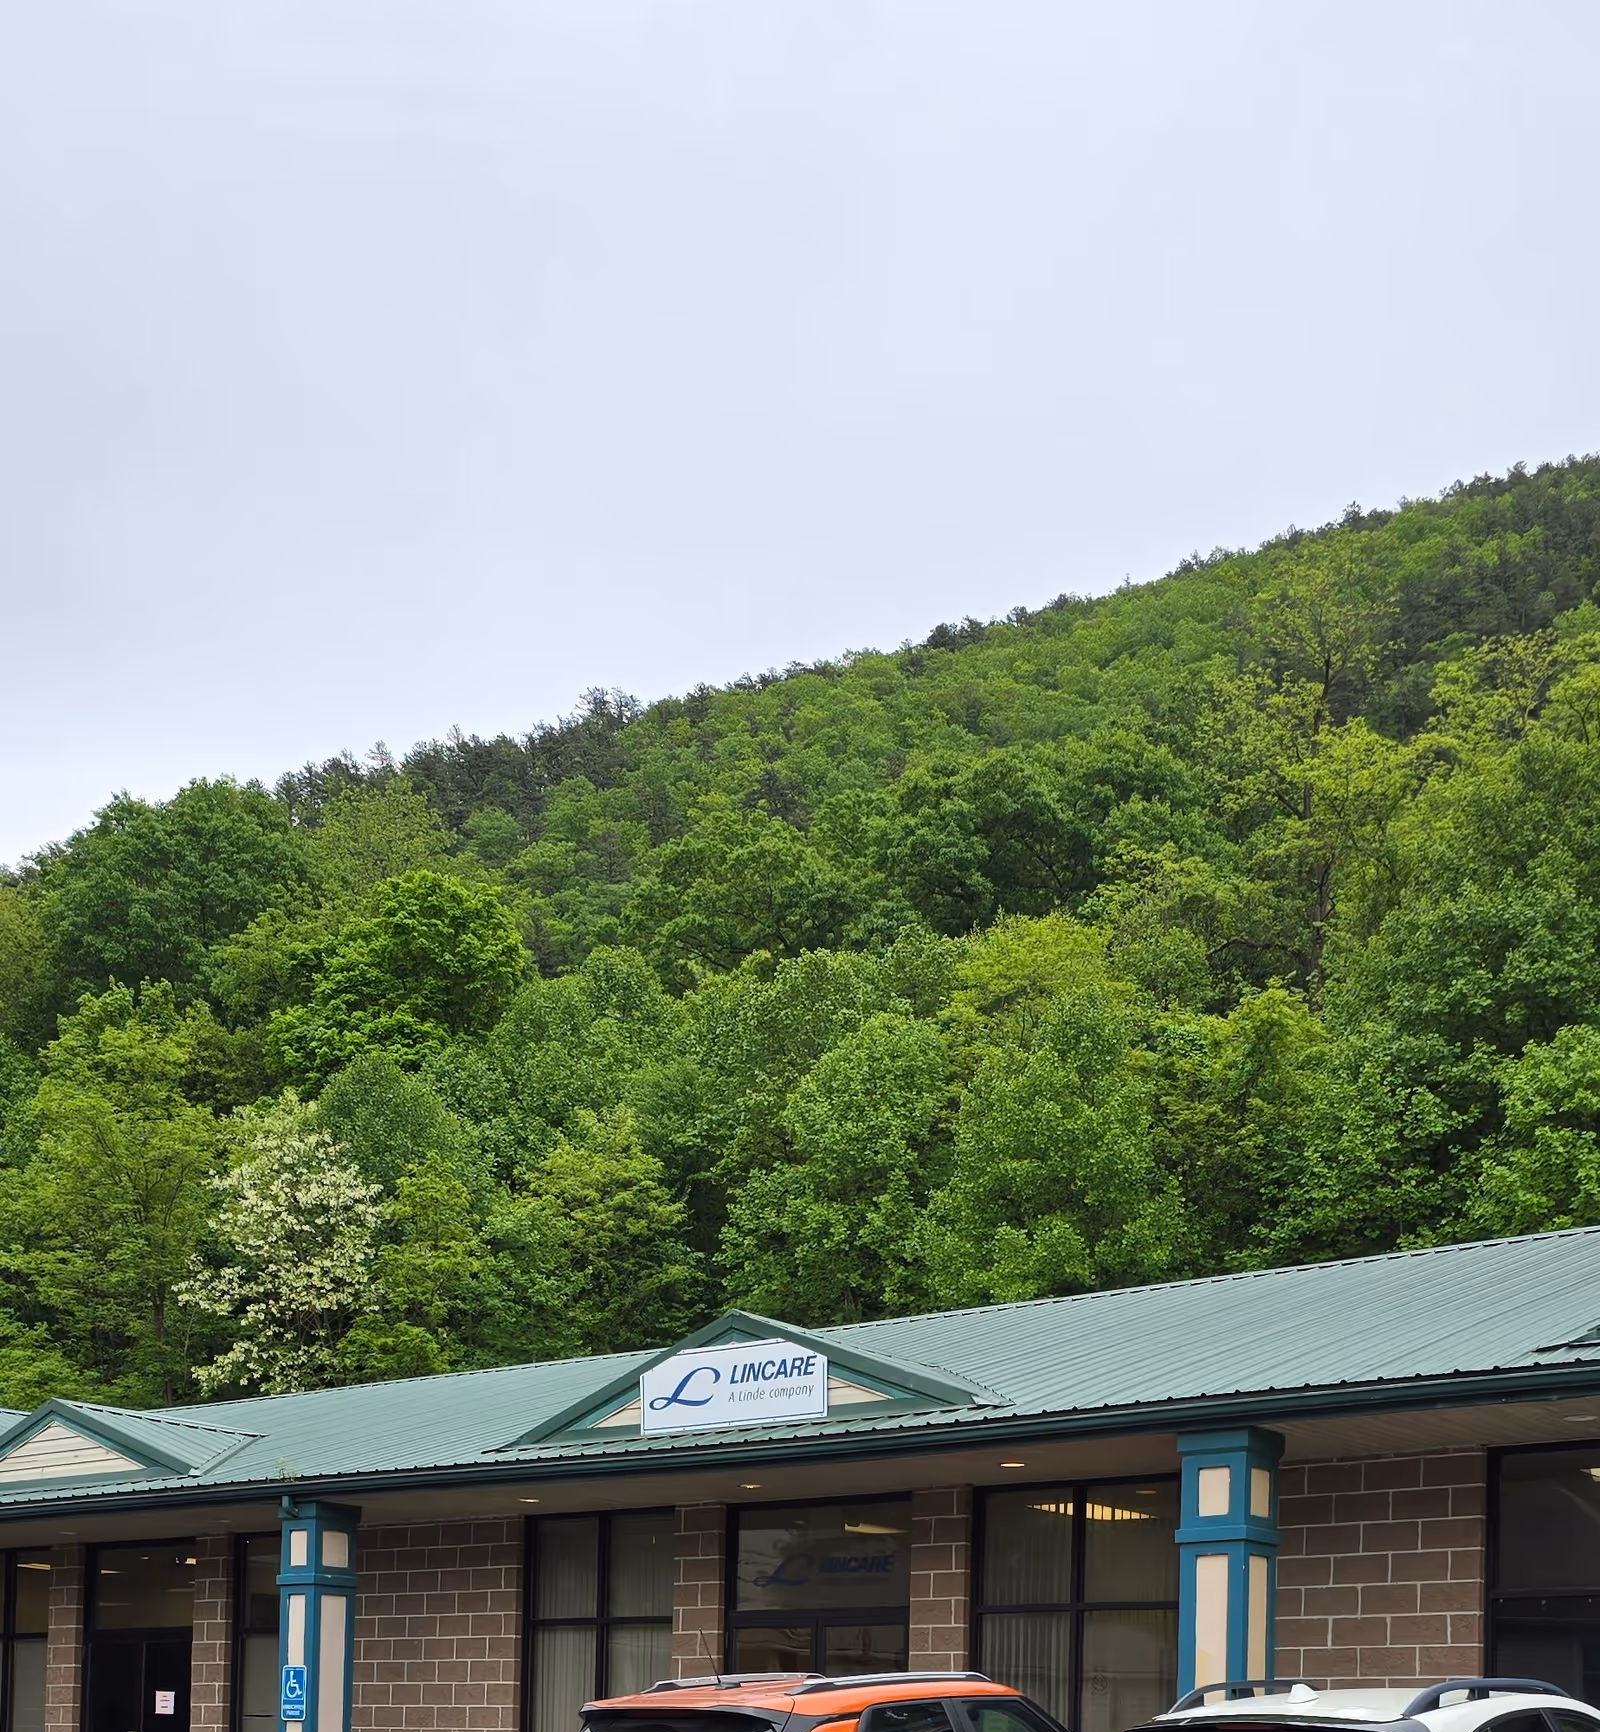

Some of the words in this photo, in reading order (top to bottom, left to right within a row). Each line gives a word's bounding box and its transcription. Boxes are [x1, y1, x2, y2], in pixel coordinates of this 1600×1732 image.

[729, 1354, 818, 1385] LINCARE
[728, 1391, 735, 1403] A
[738, 1387, 766, 1402] Linde
[768, 1385, 815, 1400] company
[819, 1554, 896, 1573] LINCARE
